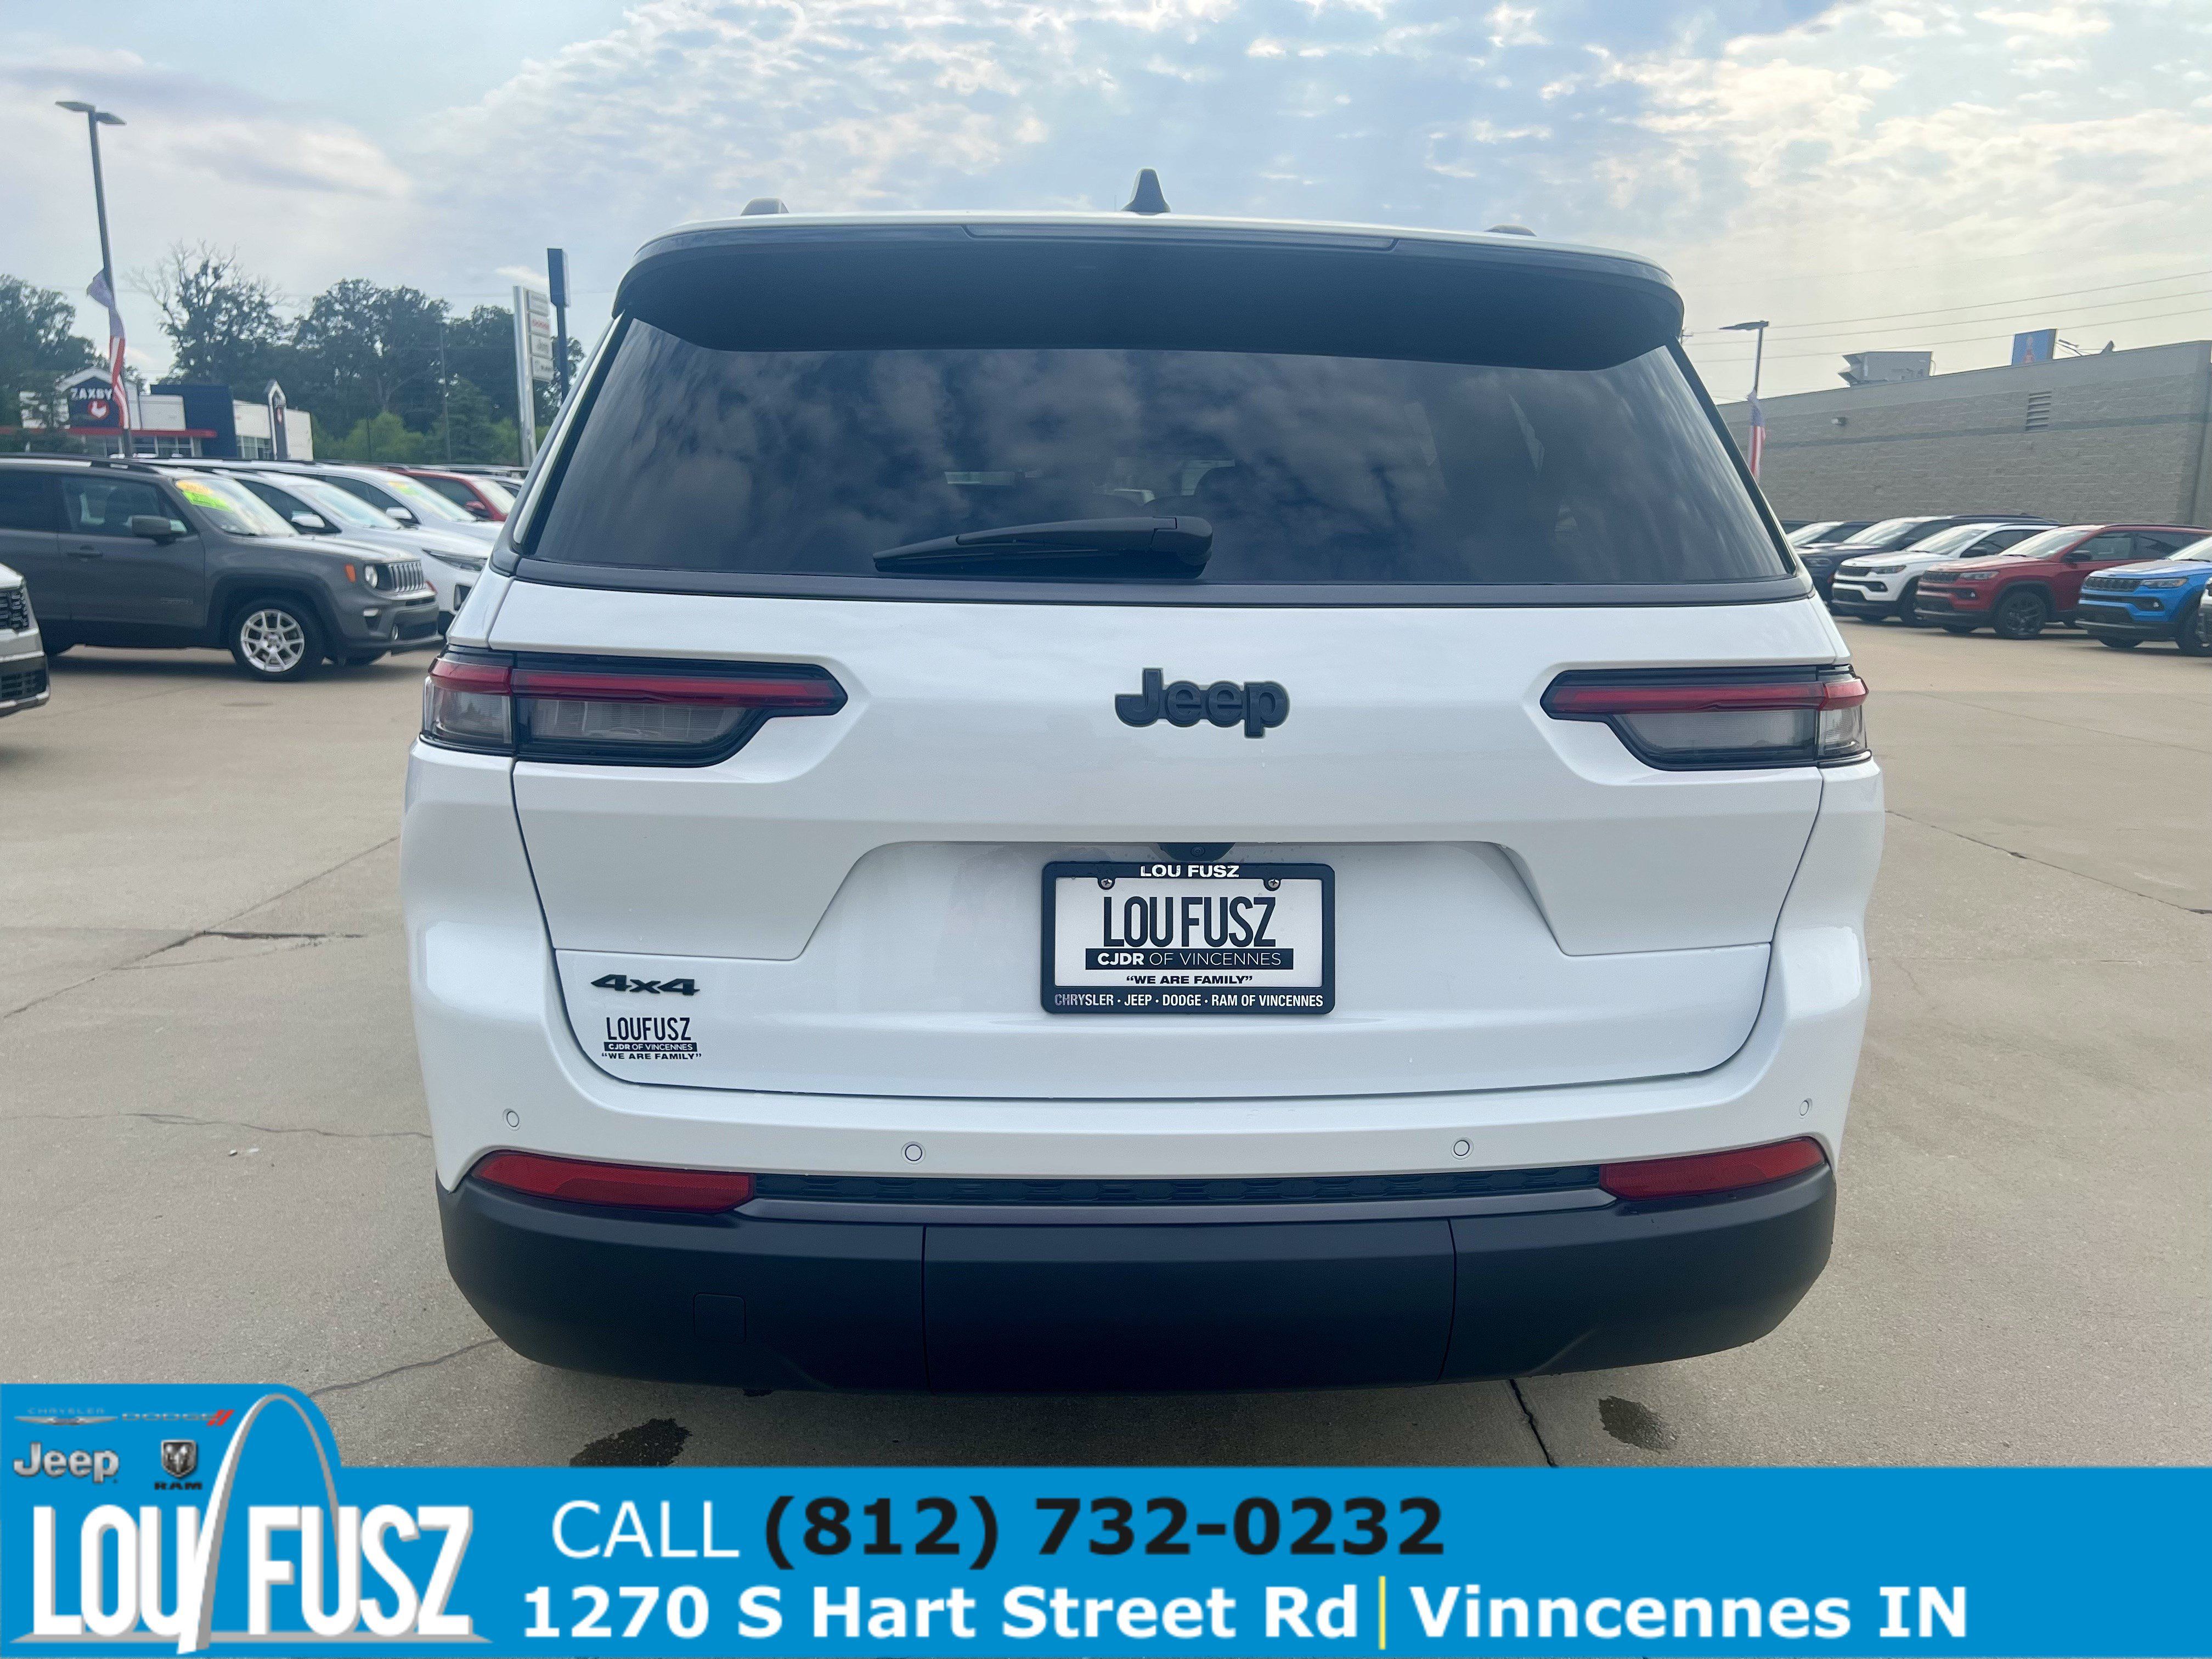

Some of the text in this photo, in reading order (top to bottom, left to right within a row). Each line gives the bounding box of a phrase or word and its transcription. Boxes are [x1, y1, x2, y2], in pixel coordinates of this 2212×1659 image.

[1115, 668, 1290, 738] Jeep
[1140, 864, 1240, 878] LOU FUSZ
[1103, 895, 1277, 948] LOU FUSZ
[1097, 952, 1282, 966] CJDR OF VINCENNES
[591, 974, 700, 996] 4x4
[1160, 975, 1191, 985] ARE
[1054, 994, 1324, 1007] CHRYSLER JEEP DODGE RAM OF VINCENNES
